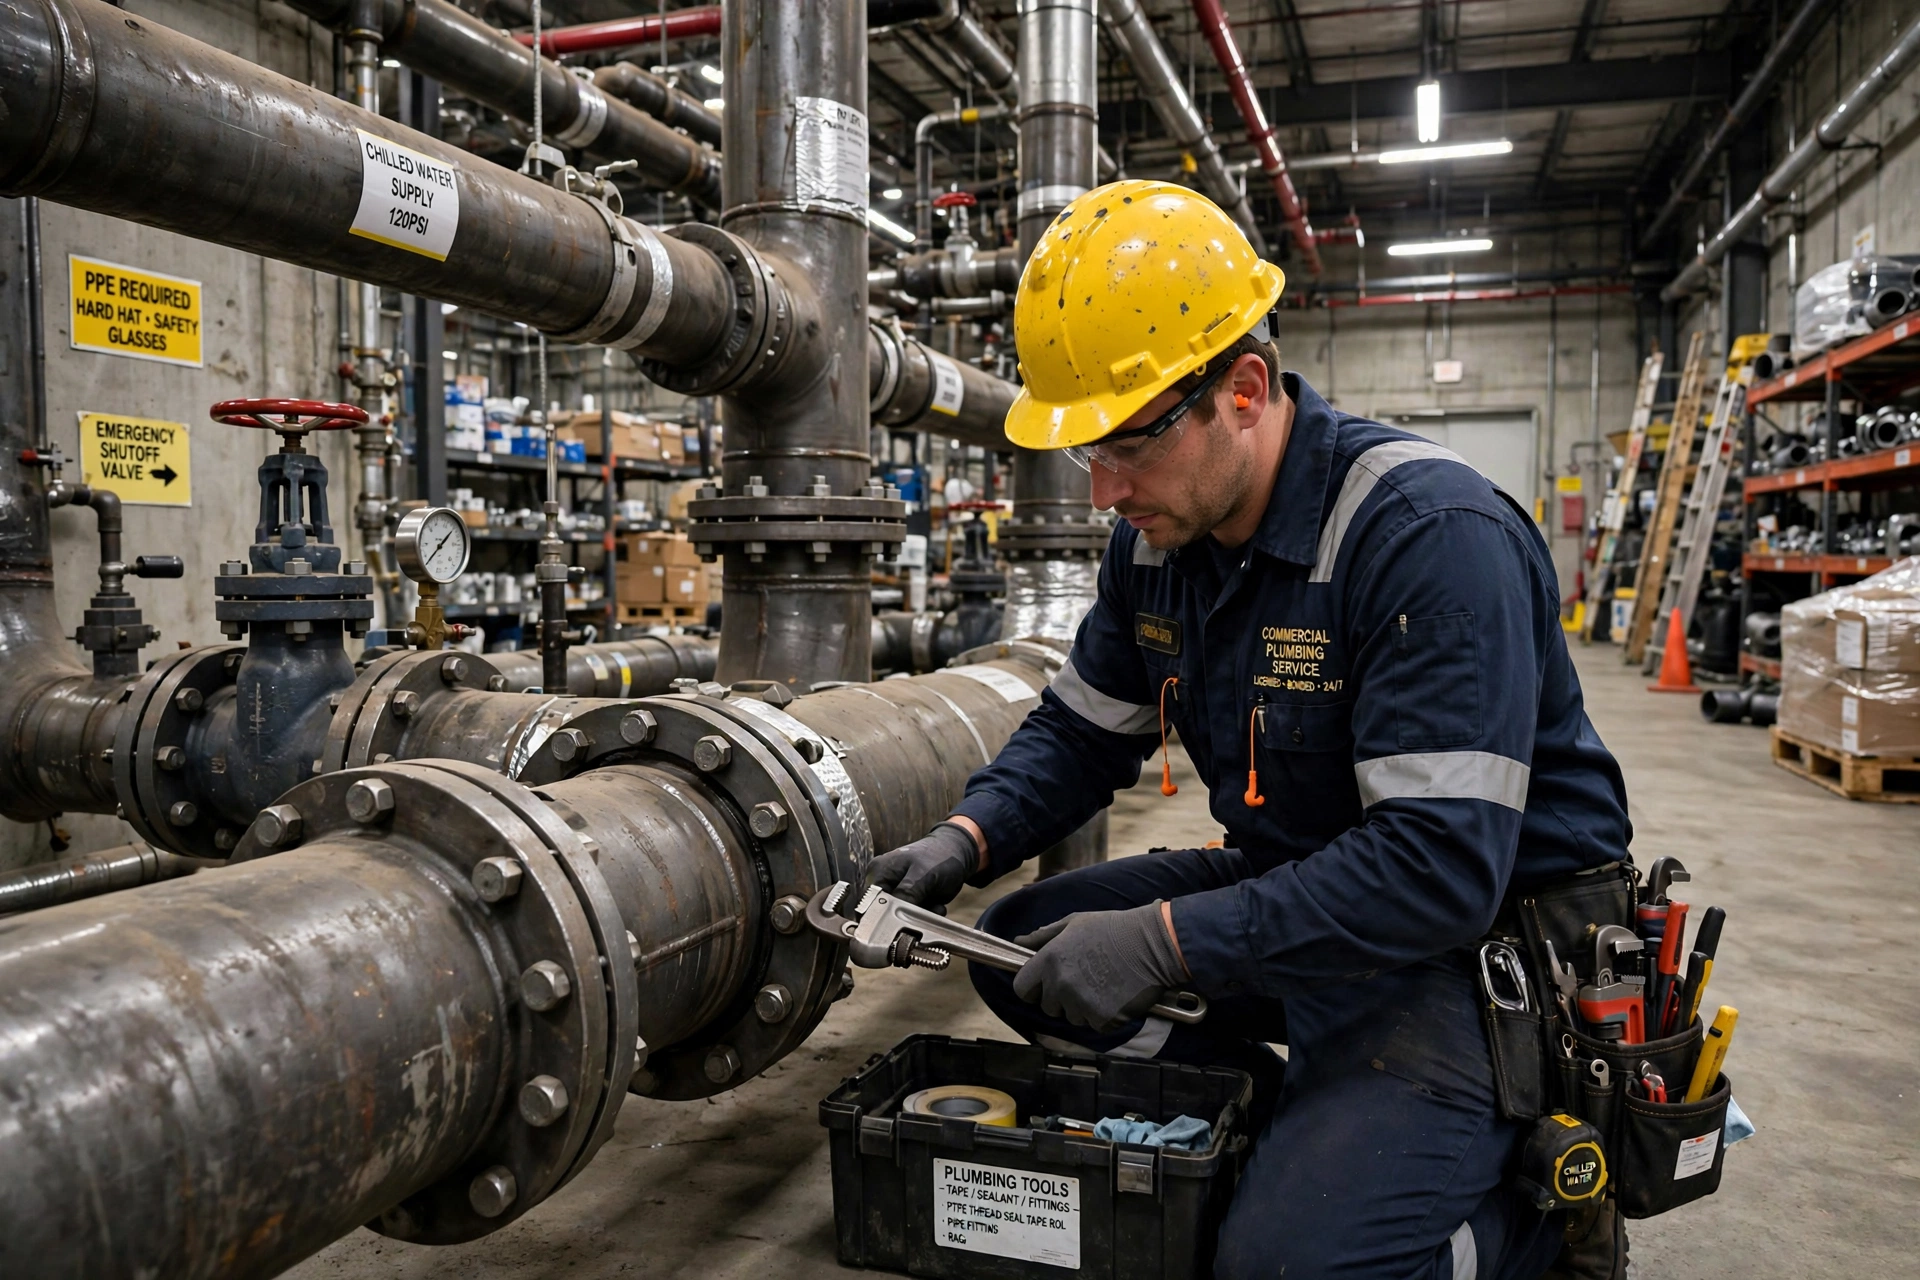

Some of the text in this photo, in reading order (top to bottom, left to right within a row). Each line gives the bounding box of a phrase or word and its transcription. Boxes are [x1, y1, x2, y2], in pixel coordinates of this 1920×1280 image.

[366, 142, 454, 190] CHILLED WATER
[391, 177, 434, 209] SUPPLY
[389, 207, 429, 236] 120PSI
[85, 271, 191, 310] PPE REQUIRED
[76, 298, 199, 336] HARD HAT SAFETY
[108, 326, 167, 351] GLASSES
[96, 420, 175, 445] EMERGENCY
[100, 441, 160, 463] SHUTOFF
[100, 461, 143, 480] VALVE
[1262, 626, 1331, 643] COMMERCIAL
[1266, 643, 1324, 660] PLUMBING
[1272, 660, 1321, 677] SERVICE
[1322, 679, 1343, 692] 24/7
[944, 1165, 1069, 1198] PLUMBING TOOLS
[946, 1184, 969, 1198] TAPE
[976, 1189, 1019, 1206] SEALANT
[1028, 1196, 1070, 1213] FITTINGS
[946, 1201, 967, 1215] PTFE
[1003, 1211, 1025, 1224] SEAL
[1026, 1214, 1048, 1228] TAPE
[1049, 1218, 1067, 1230] ROL
